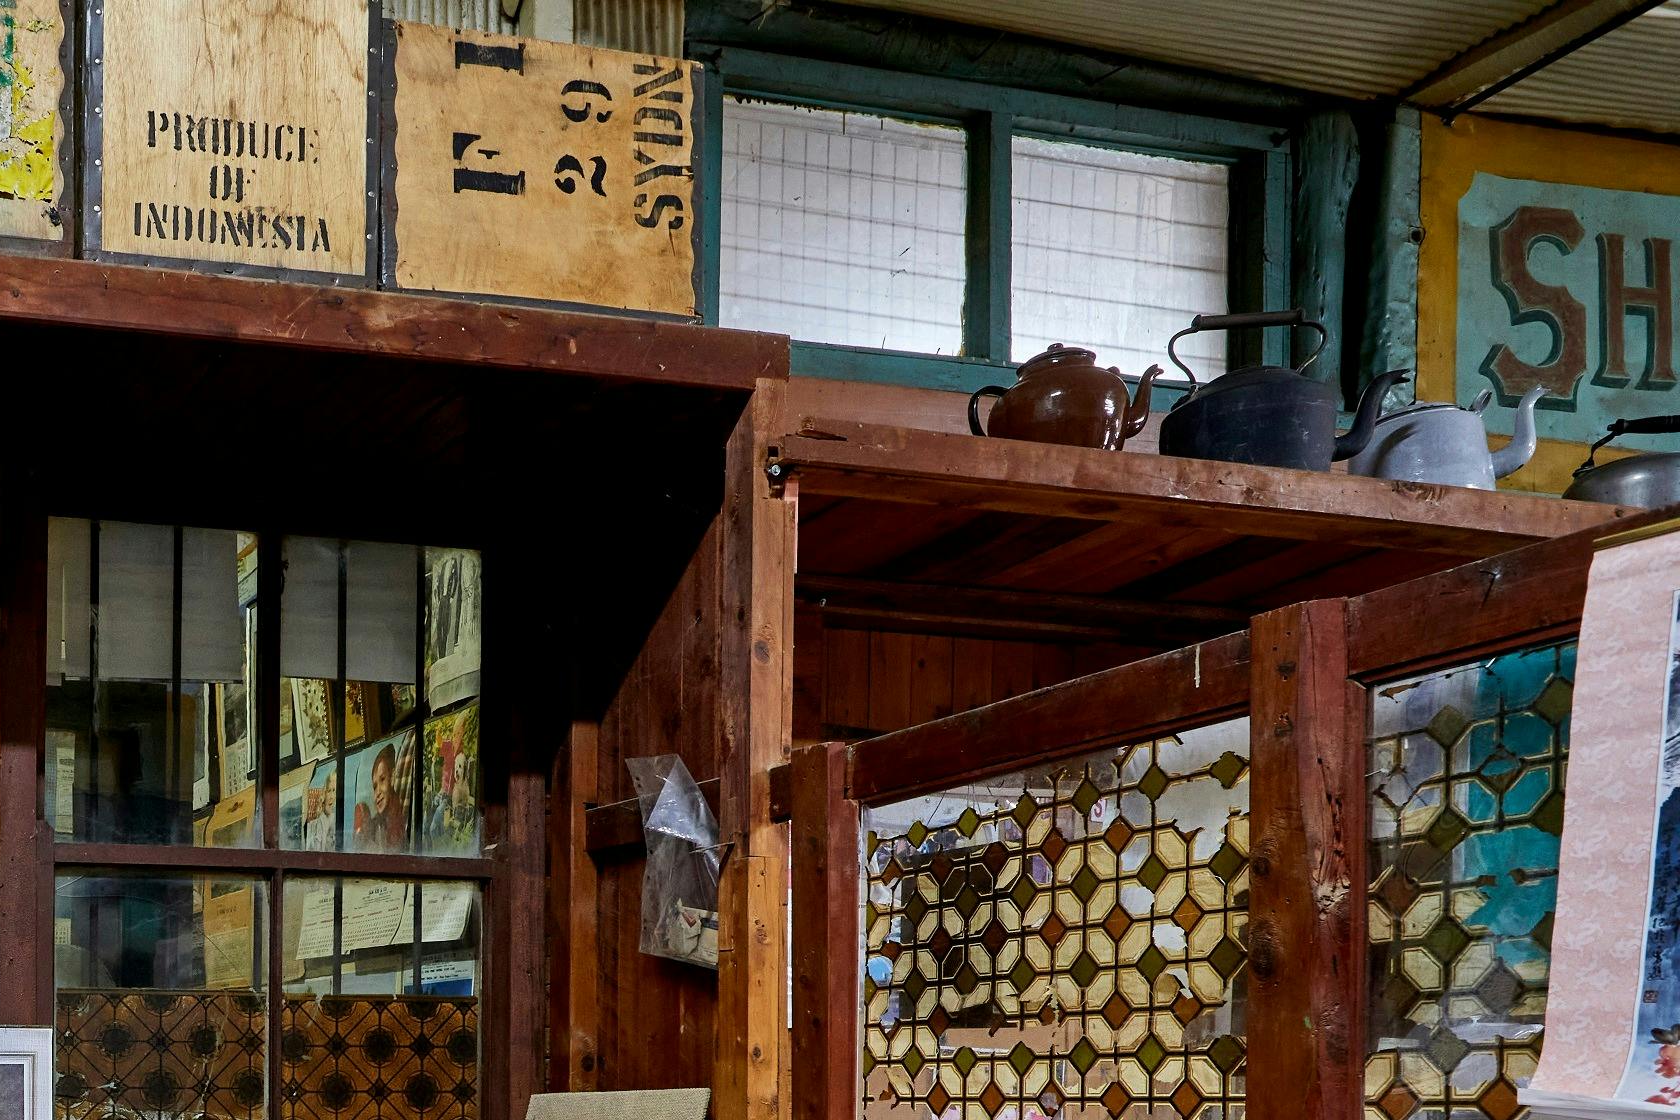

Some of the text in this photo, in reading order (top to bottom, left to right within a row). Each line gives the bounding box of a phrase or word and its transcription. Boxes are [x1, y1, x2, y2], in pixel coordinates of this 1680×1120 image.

[147, 110, 319, 164] PRODUCE
[209, 164, 256, 203] OF
[133, 202, 331, 253] INDONESIA
